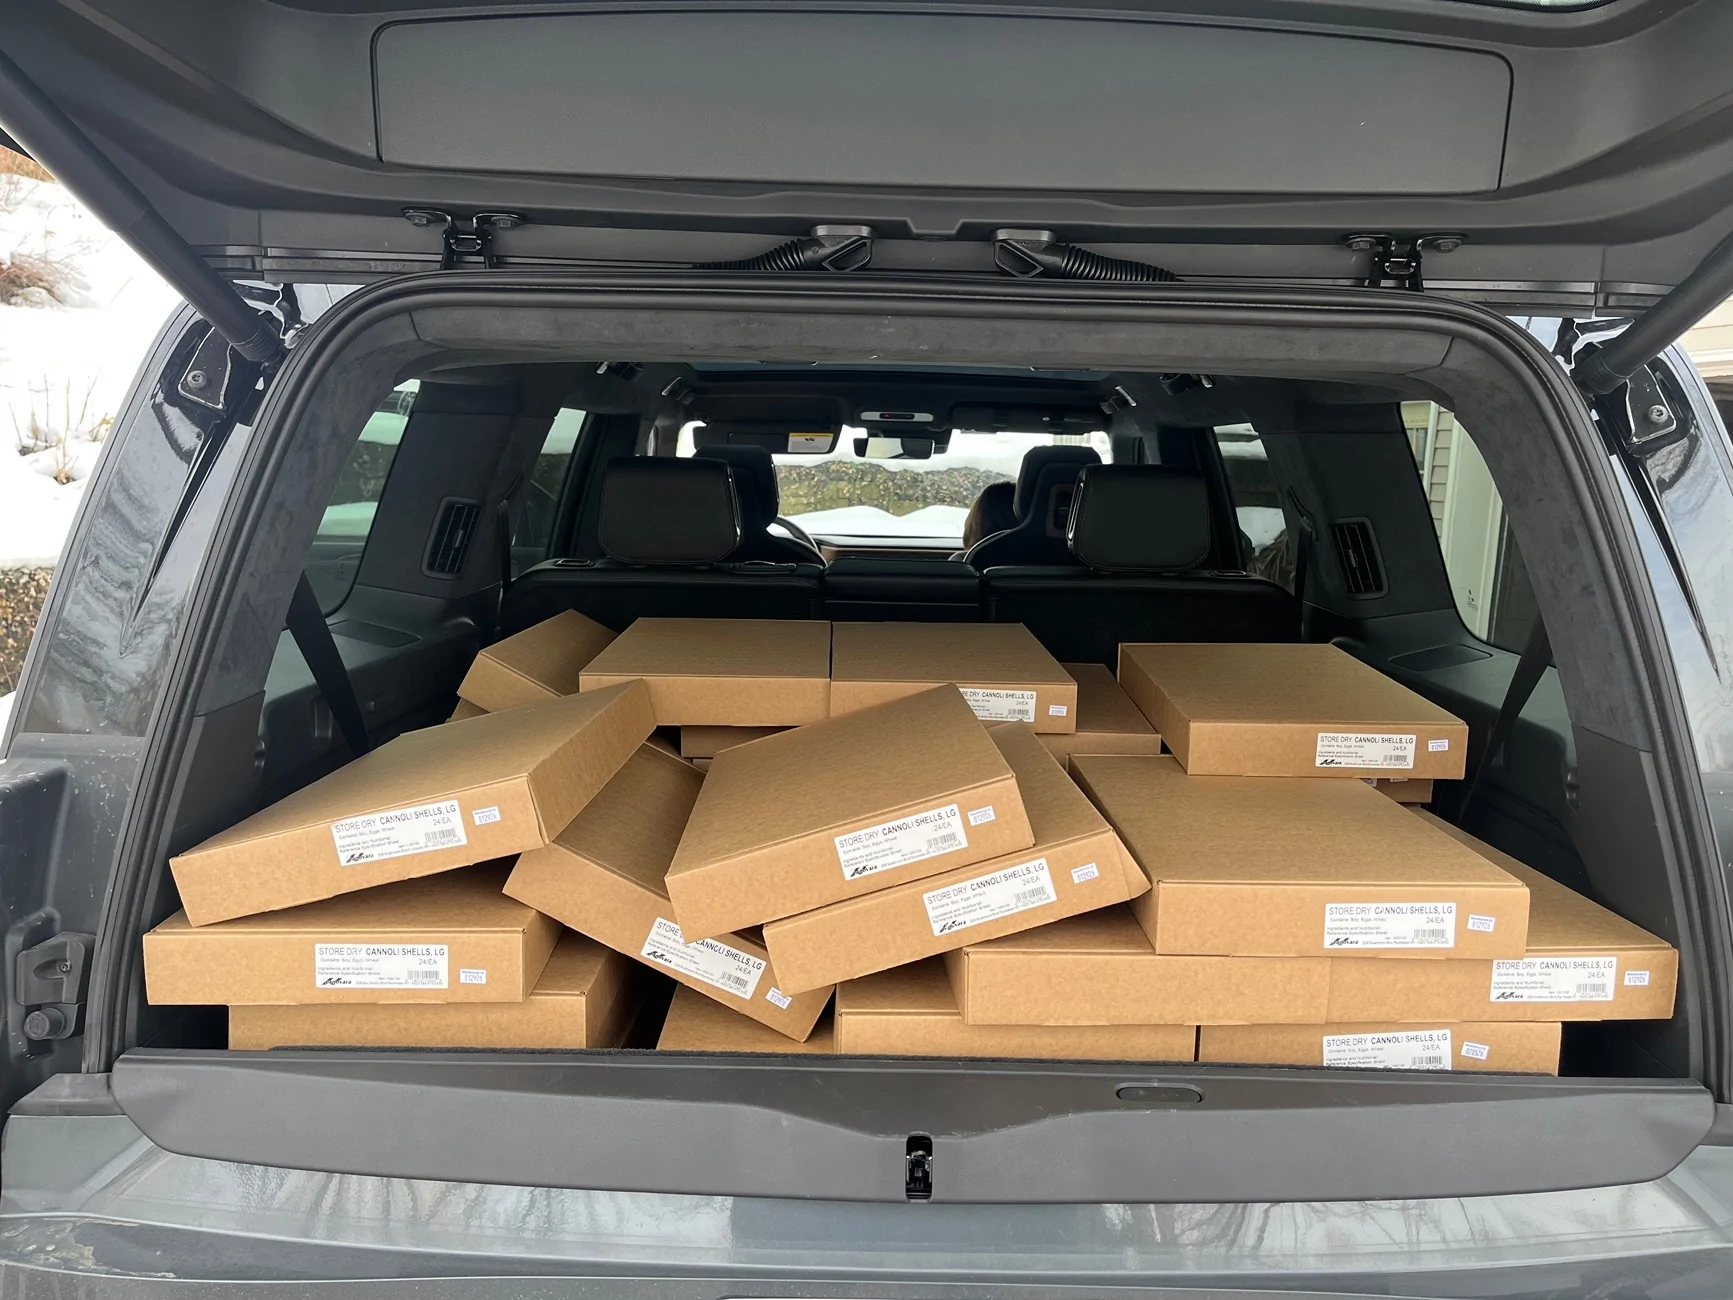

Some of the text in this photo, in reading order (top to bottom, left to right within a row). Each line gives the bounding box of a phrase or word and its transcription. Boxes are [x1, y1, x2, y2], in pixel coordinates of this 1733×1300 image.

[335, 804, 456, 833] STORE DRY CANNOLI SHELLS, LG
[839, 835, 864, 848] STORE
[864, 830, 878, 841] DRY
[882, 820, 914, 836] CANNOLI
[915, 812, 945, 827] SHELLS,
[945, 809, 956, 818] LG
[927, 863, 1044, 904] STORE DRY CANNOLI SHELLS, LG
[1329, 906, 1452, 915] STORE DRY CANNOLI SHELLS, LG
[657, 922, 680, 936] STORE
[319, 947, 345, 955] STORE
[366, 948, 399, 956] CANNOLI
[401, 948, 432, 957] SHELLS,
[435, 948, 444, 956] LG
[695, 940, 725, 955] CANNOLI
[725, 950, 750, 967] SHELLS,
[752, 961, 762, 970] LG
[1496, 962, 1520, 970] STORE
[1540, 961, 1571, 969] CANNOLI
[1573, 961, 1601, 970] SHELLS,
[1604, 961, 1613, 969] LG
[1326, 1038, 1351, 1047] STORE
[1371, 1036, 1403, 1044] CANNOLI
[1405, 1034, 1435, 1043] SHELLS,
